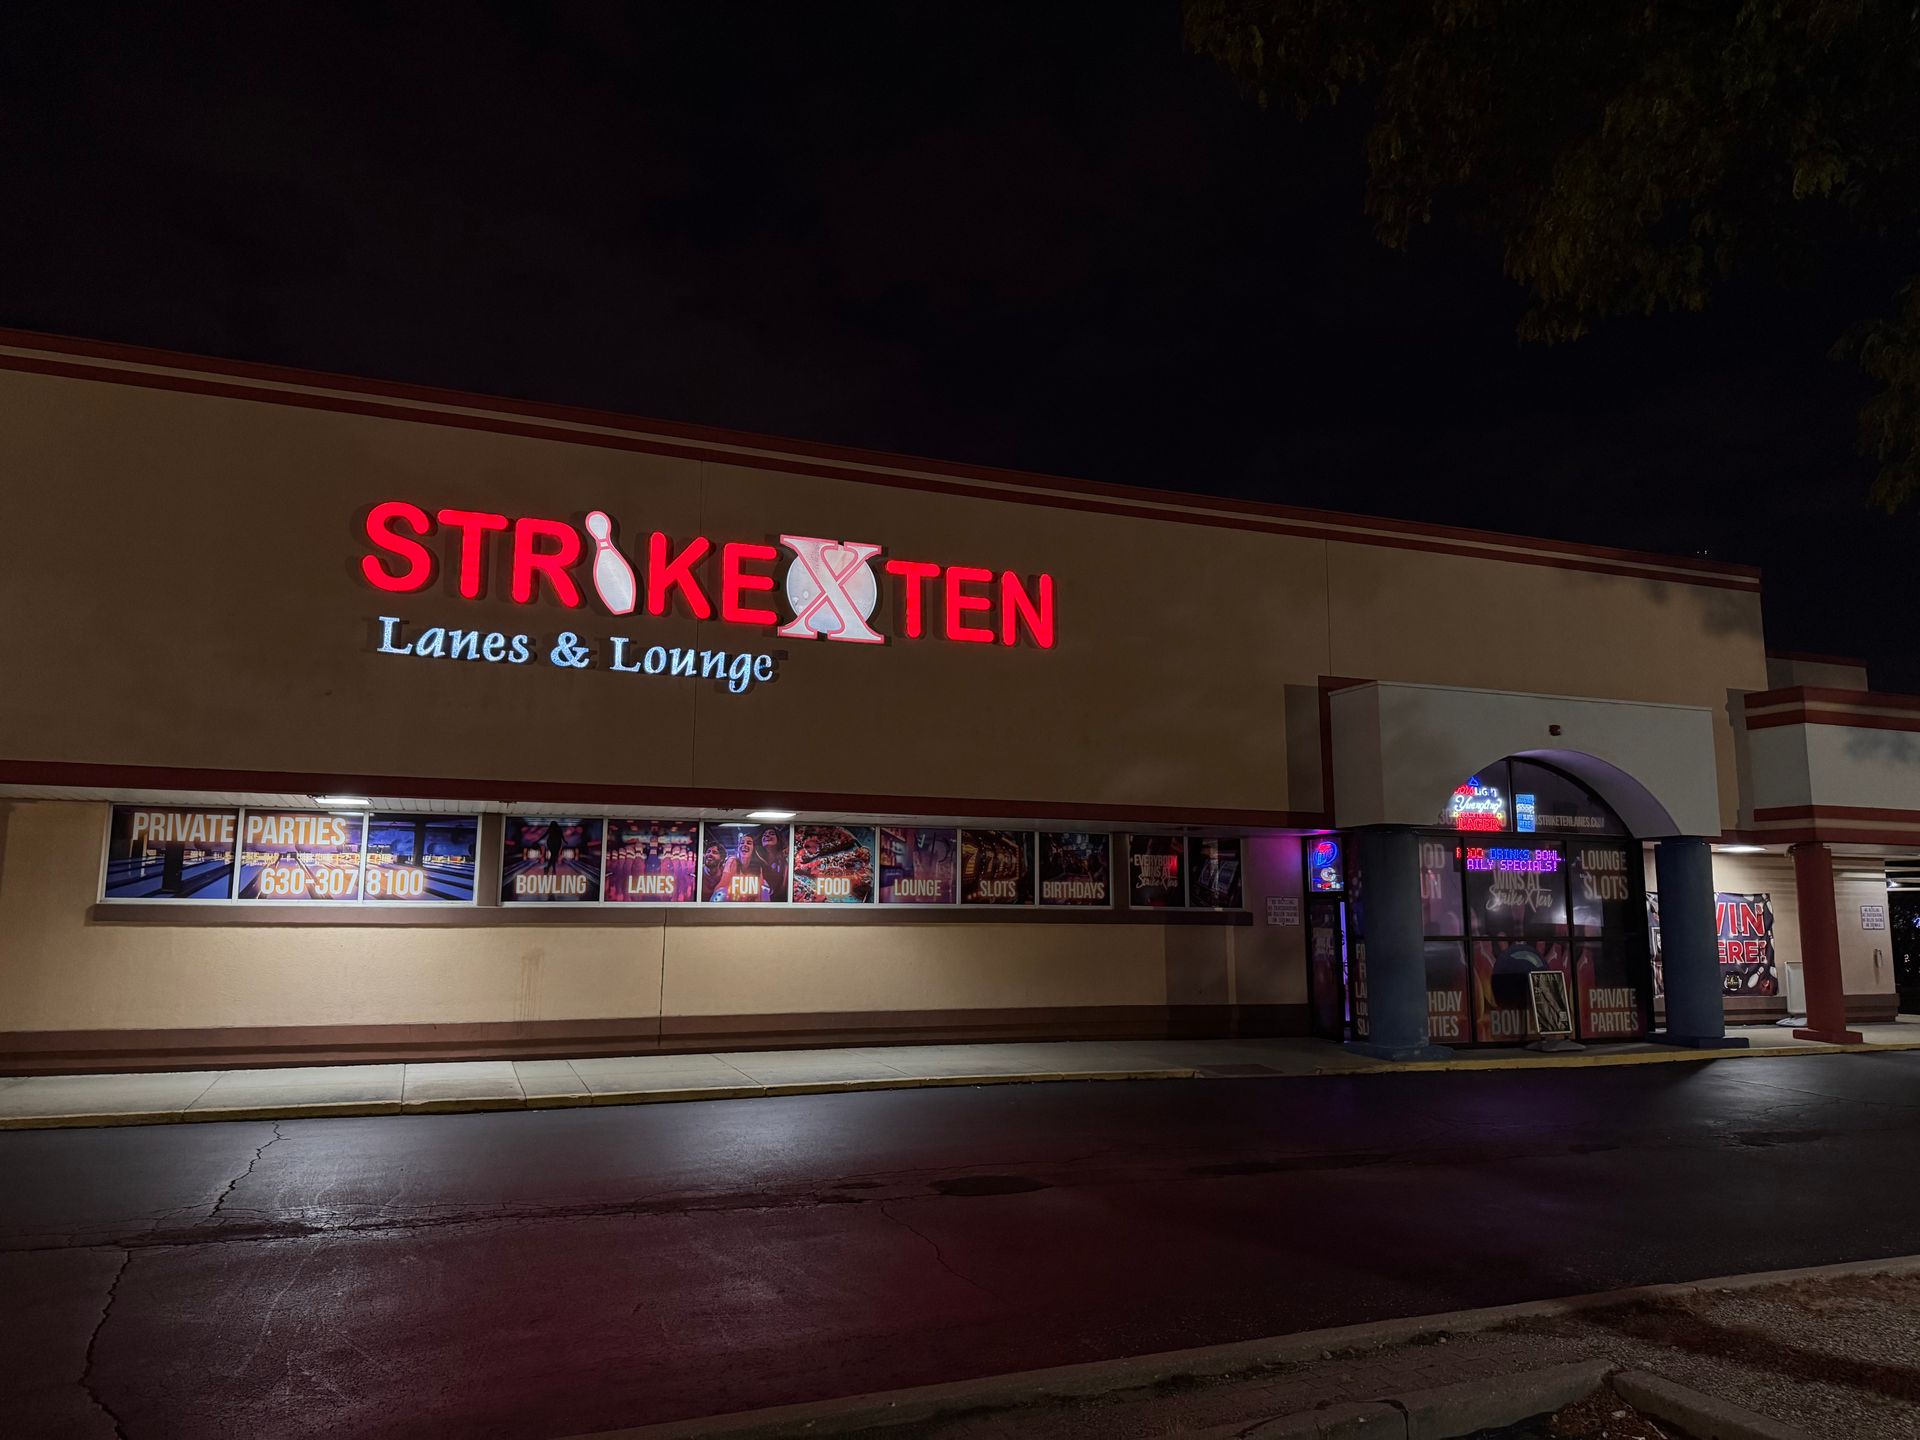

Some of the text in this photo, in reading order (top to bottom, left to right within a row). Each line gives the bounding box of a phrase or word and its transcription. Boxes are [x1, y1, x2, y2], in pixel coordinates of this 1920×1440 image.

[886, 560, 1053, 649] TEN
[377, 616, 774, 692] Lanes & Lounge
[132, 812, 347, 846] PRIVATE PARTIES
[1457, 817, 1500, 831] LAGER
[1133, 854, 1178, 866] EVERYBODY
[1489, 848, 1530, 860] DRINKS
[1580, 849, 1628, 872] LOUNGE
[1467, 858, 1558, 872] AILY SPECIALS!
[516, 874, 587, 895] BOWLING
[628, 874, 674, 895] LANES
[731, 875, 759, 896] FUN
[816, 877, 851, 896] FOOD
[894, 879, 942, 897] LOUNGE
[980, 880, 1016, 898] SLOTS
[1043, 881, 1105, 900] BIRTHDAYS
[1420, 872, 1442, 900] UN
[1493, 870, 1541, 890] WINS AT
[1583, 875, 1629, 900] SLOTS
[1485, 886, 1525, 911] Strike
[1718, 940, 1767, 963] ERE!
[1589, 988, 1637, 1009] PRIVATE
[1428, 1015, 1459, 1037] TIES
[1590, 1010, 1639, 1032] PARTIES
